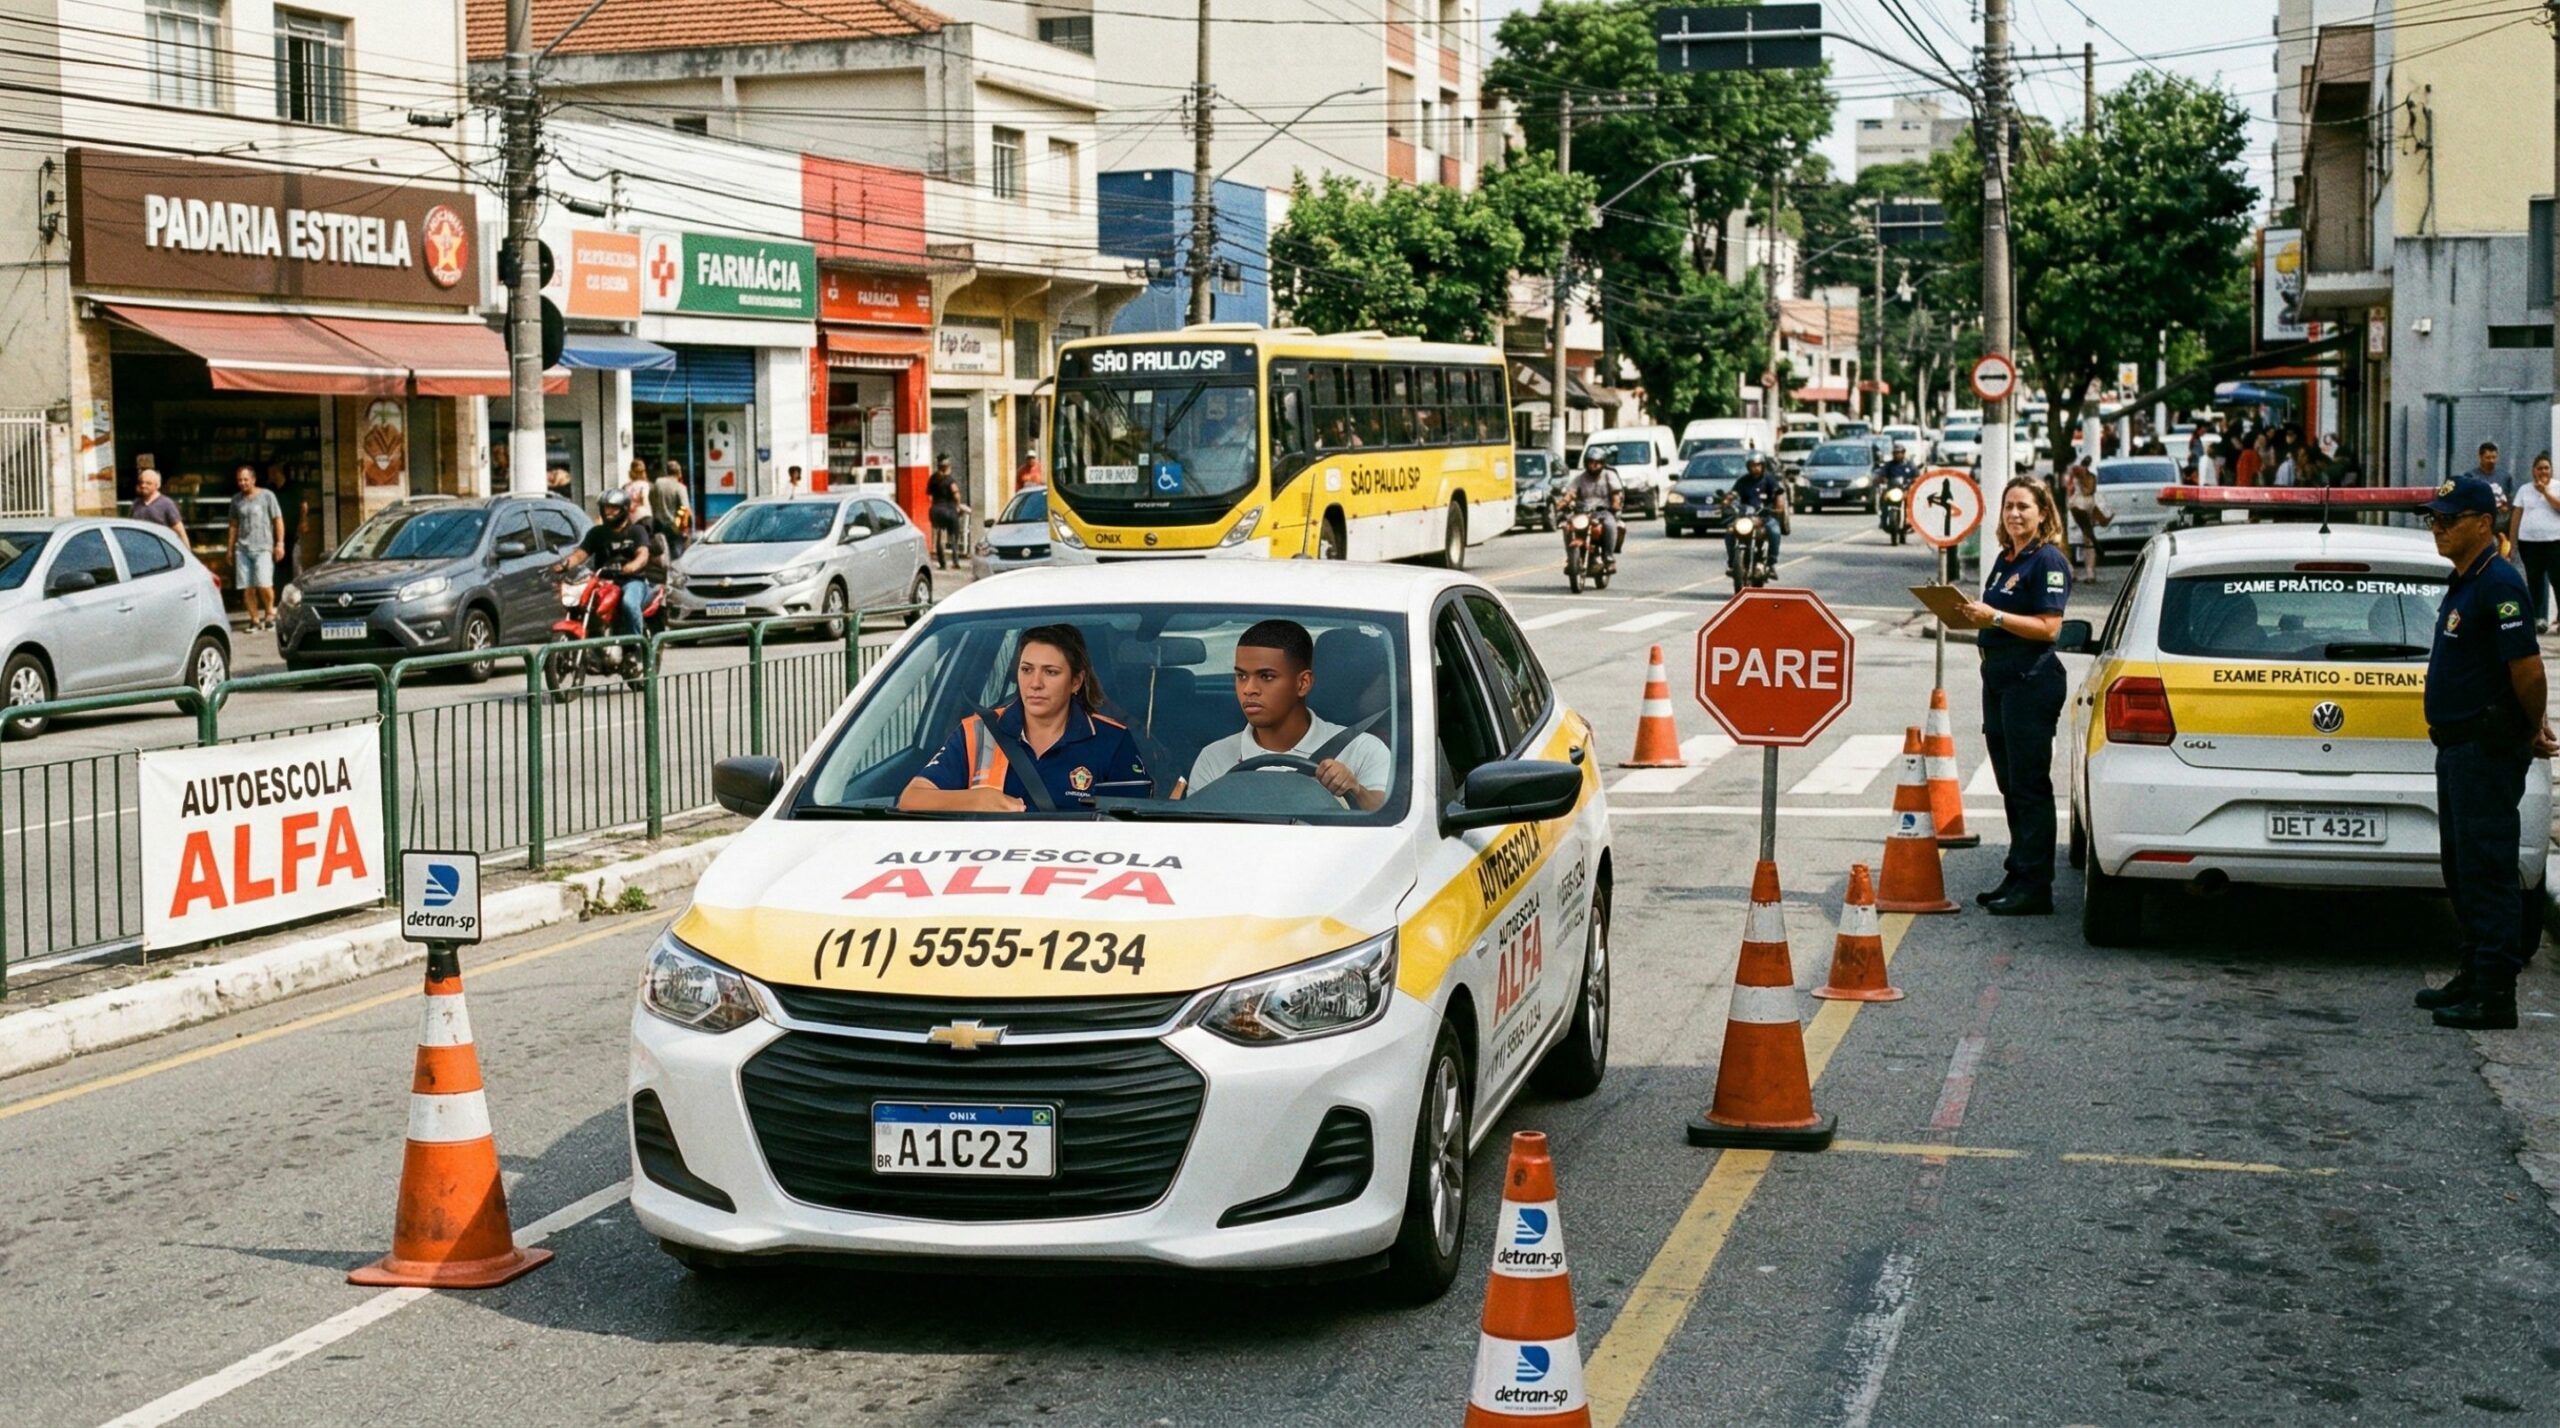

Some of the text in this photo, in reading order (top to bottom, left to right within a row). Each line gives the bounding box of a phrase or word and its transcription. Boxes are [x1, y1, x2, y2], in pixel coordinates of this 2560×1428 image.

[144, 194, 282, 257] PADARIA
[287, 209, 413, 268] ESTRELA
[697, 249, 802, 292] FARMÁCIA
[1092, 349, 1226, 373] SÃO PAULO/SP
[1351, 463, 1372, 496] SÃO
[1095, 533, 1121, 544] ONIX
[2223, 580, 2275, 595] EXAME
[2278, 576, 2344, 593] PRÁTICO
[2356, 580, 2441, 597] DETRAN-SP
[1711, 646, 1839, 690] PARE
[2213, 669, 2266, 684] EXAME
[2271, 668, 2341, 685] PRÁTICO
[2354, 671, 2427, 687] DETRAN-
[2183, 740, 2217, 750] GOL
[181, 756, 352, 818] AUTOESCOLA
[2271, 816, 2376, 838] DET 4321
[169, 805, 368, 919] ALFA
[875, 848, 1183, 870] AUTOESCOLA
[1477, 821, 1542, 910] AUTOESCOLA
[841, 866, 1176, 906] ALFA
[406, 910, 476, 931] detran-sp
[1498, 890, 1541, 950] AUTOESCOLA
[813, 927, 1147, 980] (11) 5555-1234
[1492, 914, 1543, 1028] ALFA
[948, 1111, 977, 1122] ONIX
[877, 1128, 1028, 1169] BR A1C23
[1498, 1247, 1563, 1269] detran-sp
[1495, 1385, 1568, 1407] detran-sp
